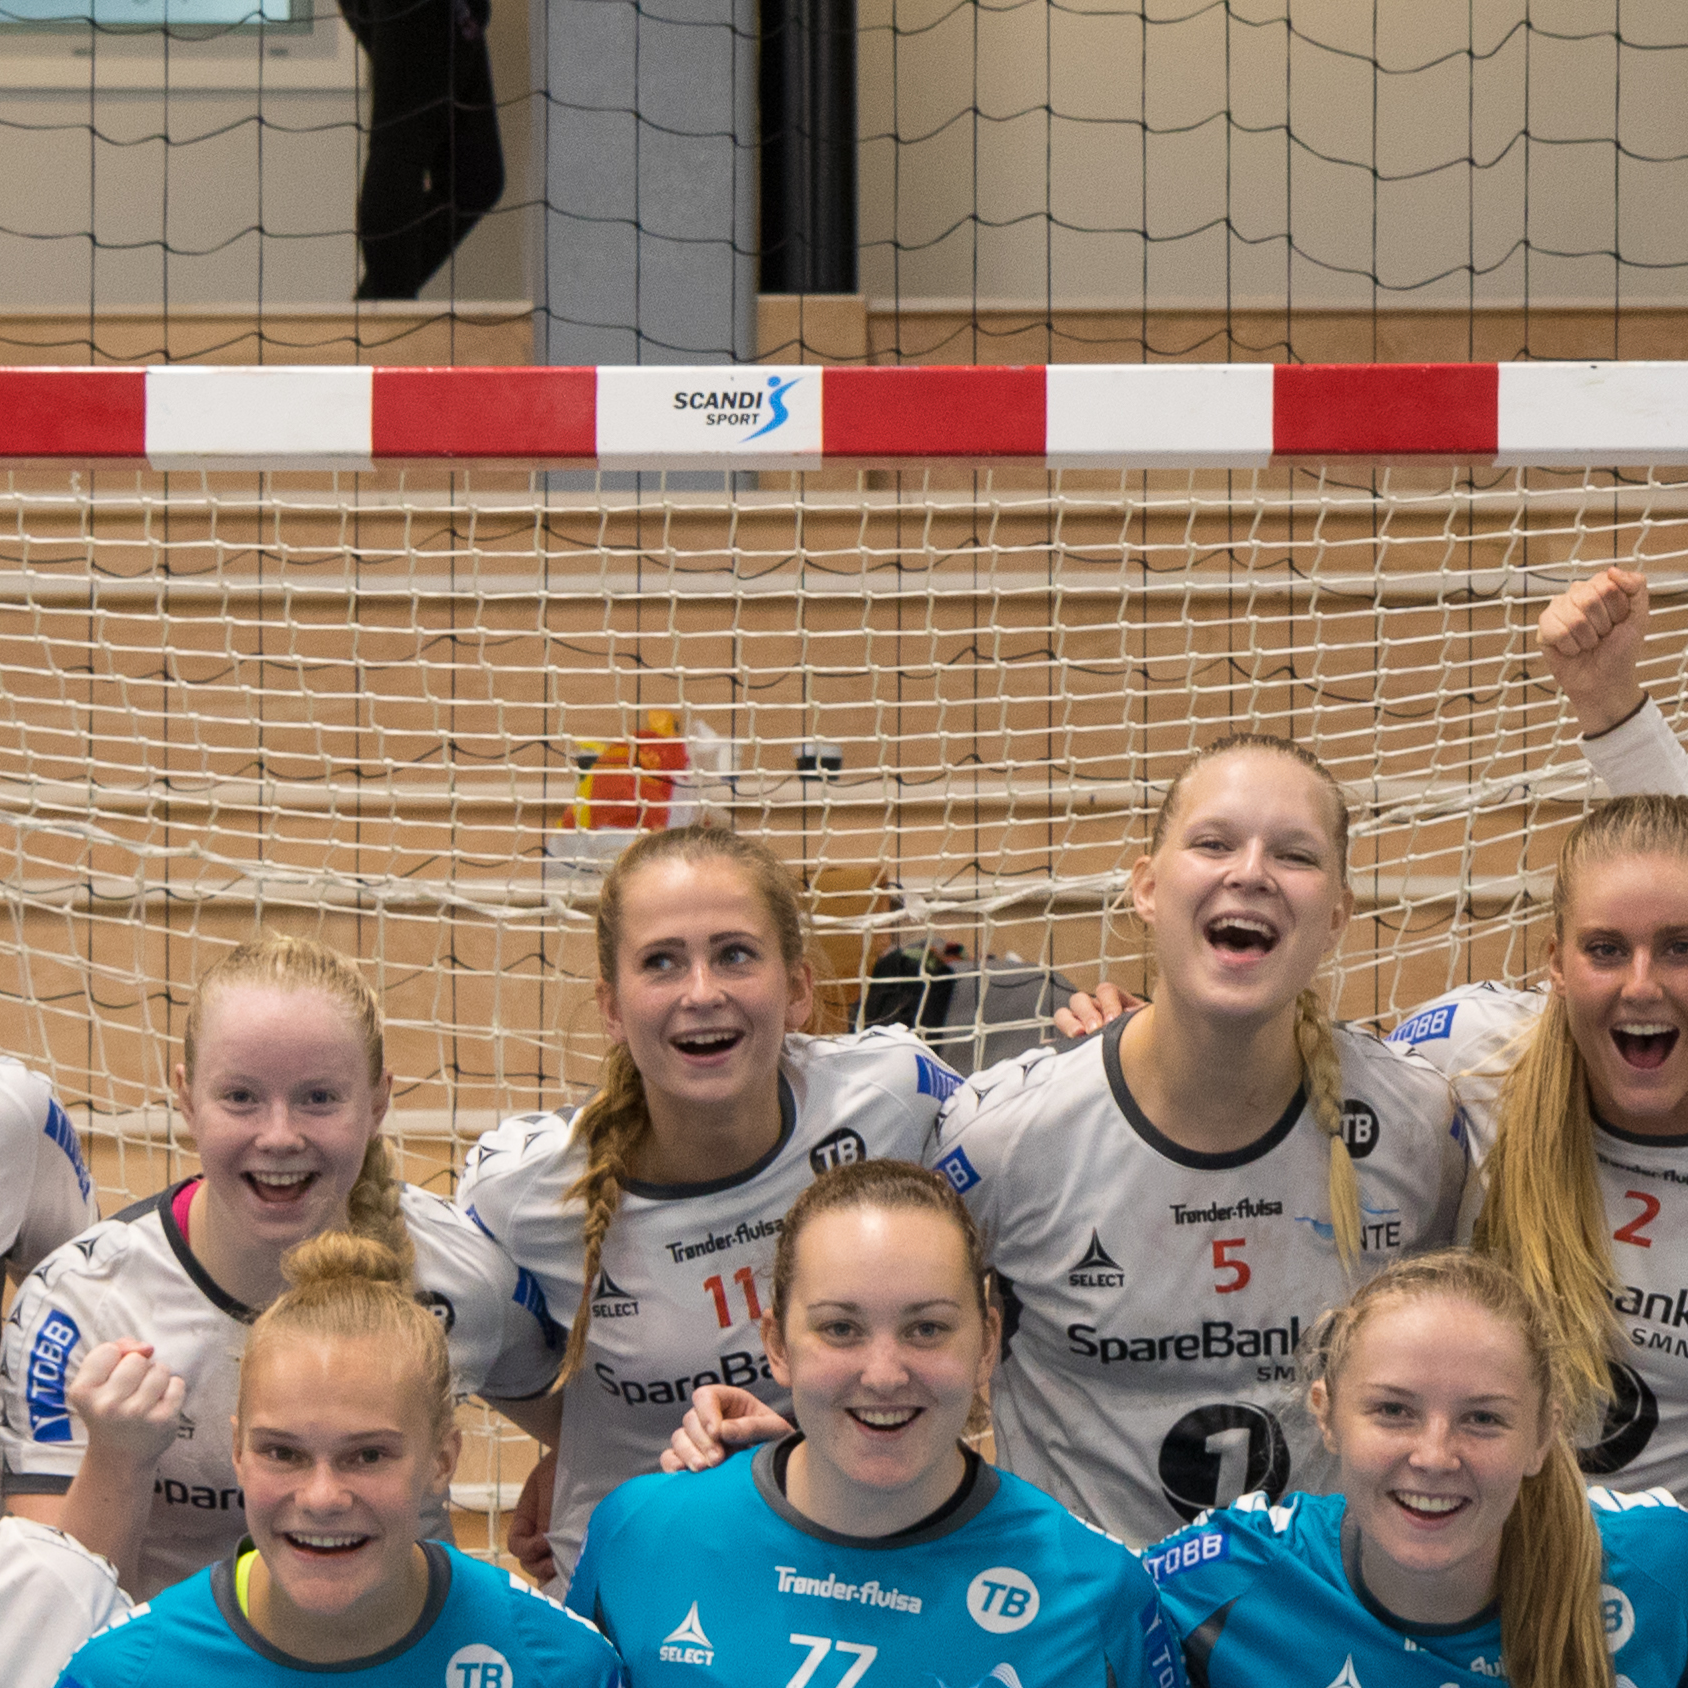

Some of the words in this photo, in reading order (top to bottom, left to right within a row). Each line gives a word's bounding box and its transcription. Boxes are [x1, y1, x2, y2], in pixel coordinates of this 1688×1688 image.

[674, 391, 764, 410] SCANDI
[706, 412, 760, 426] SPORT
[1613, 1190, 1661, 1248] 2
[1069, 1273, 1125, 1288] SELECT
[1212, 1238, 1252, 1294] 5
[592, 1302, 640, 1318] SELECT
[703, 1266, 763, 1328] 11
[31, 1319, 75, 1400] TOBB
[1149, 1533, 1223, 1582] TOBB
[979, 1580, 1029, 1618] TB
[659, 1645, 714, 1666] SELECT
